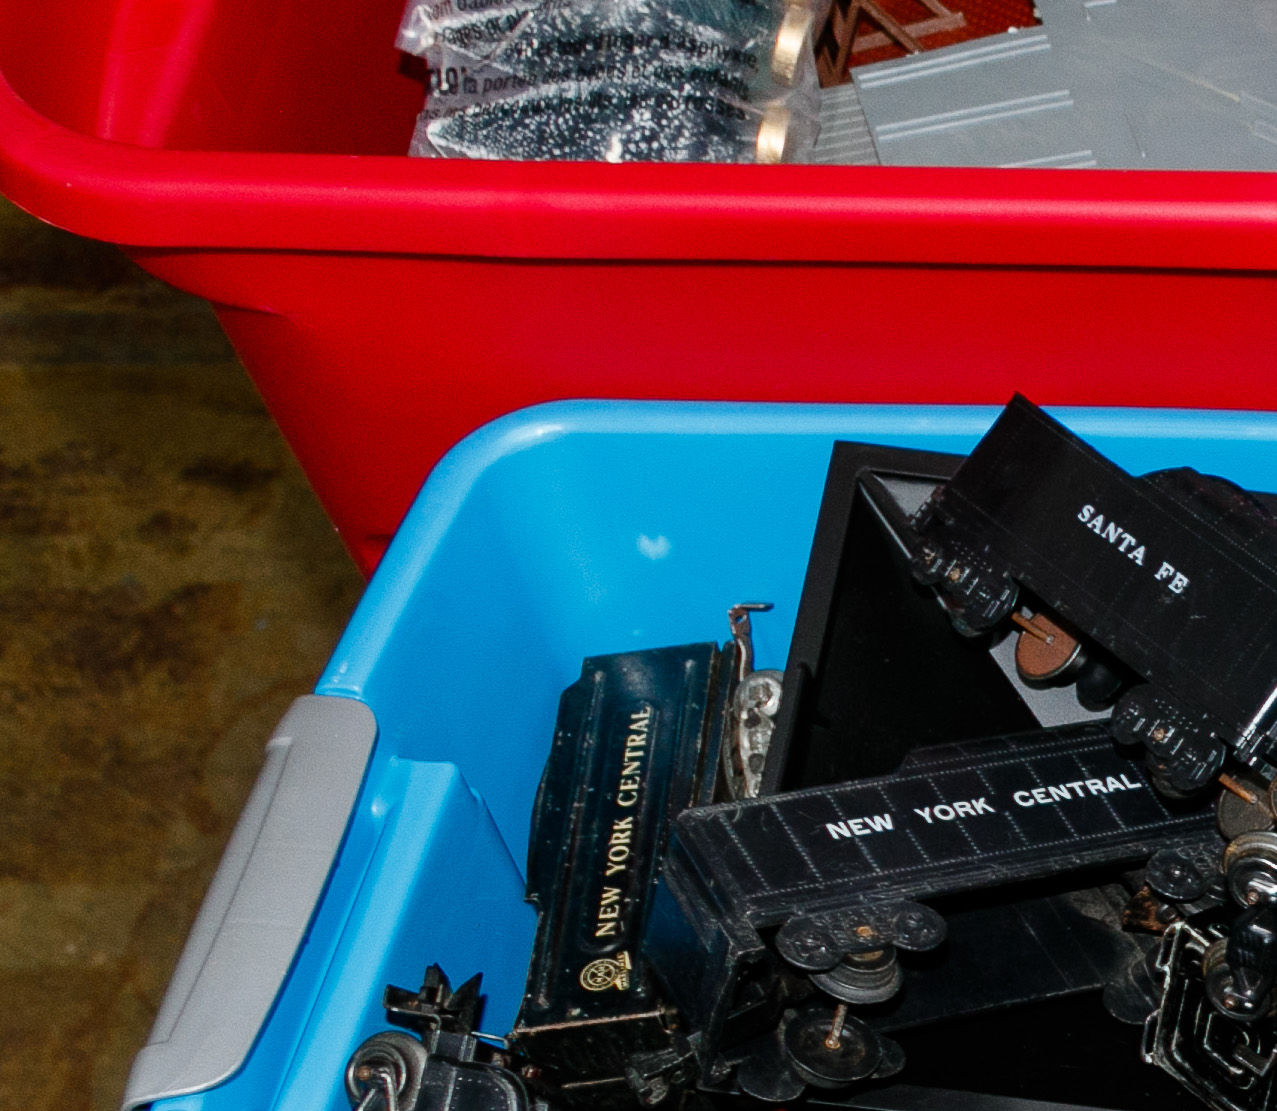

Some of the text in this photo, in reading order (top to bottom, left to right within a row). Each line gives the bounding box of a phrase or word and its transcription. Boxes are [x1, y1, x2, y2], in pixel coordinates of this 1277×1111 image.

[1078, 505, 1190, 594] SANTA FE
[616, 705, 651, 807] CENTRAL
[826, 773, 1143, 840] NEW YORK CENTRAL
[604, 816, 633, 877] YORK
[595, 886, 622, 937] NEW
